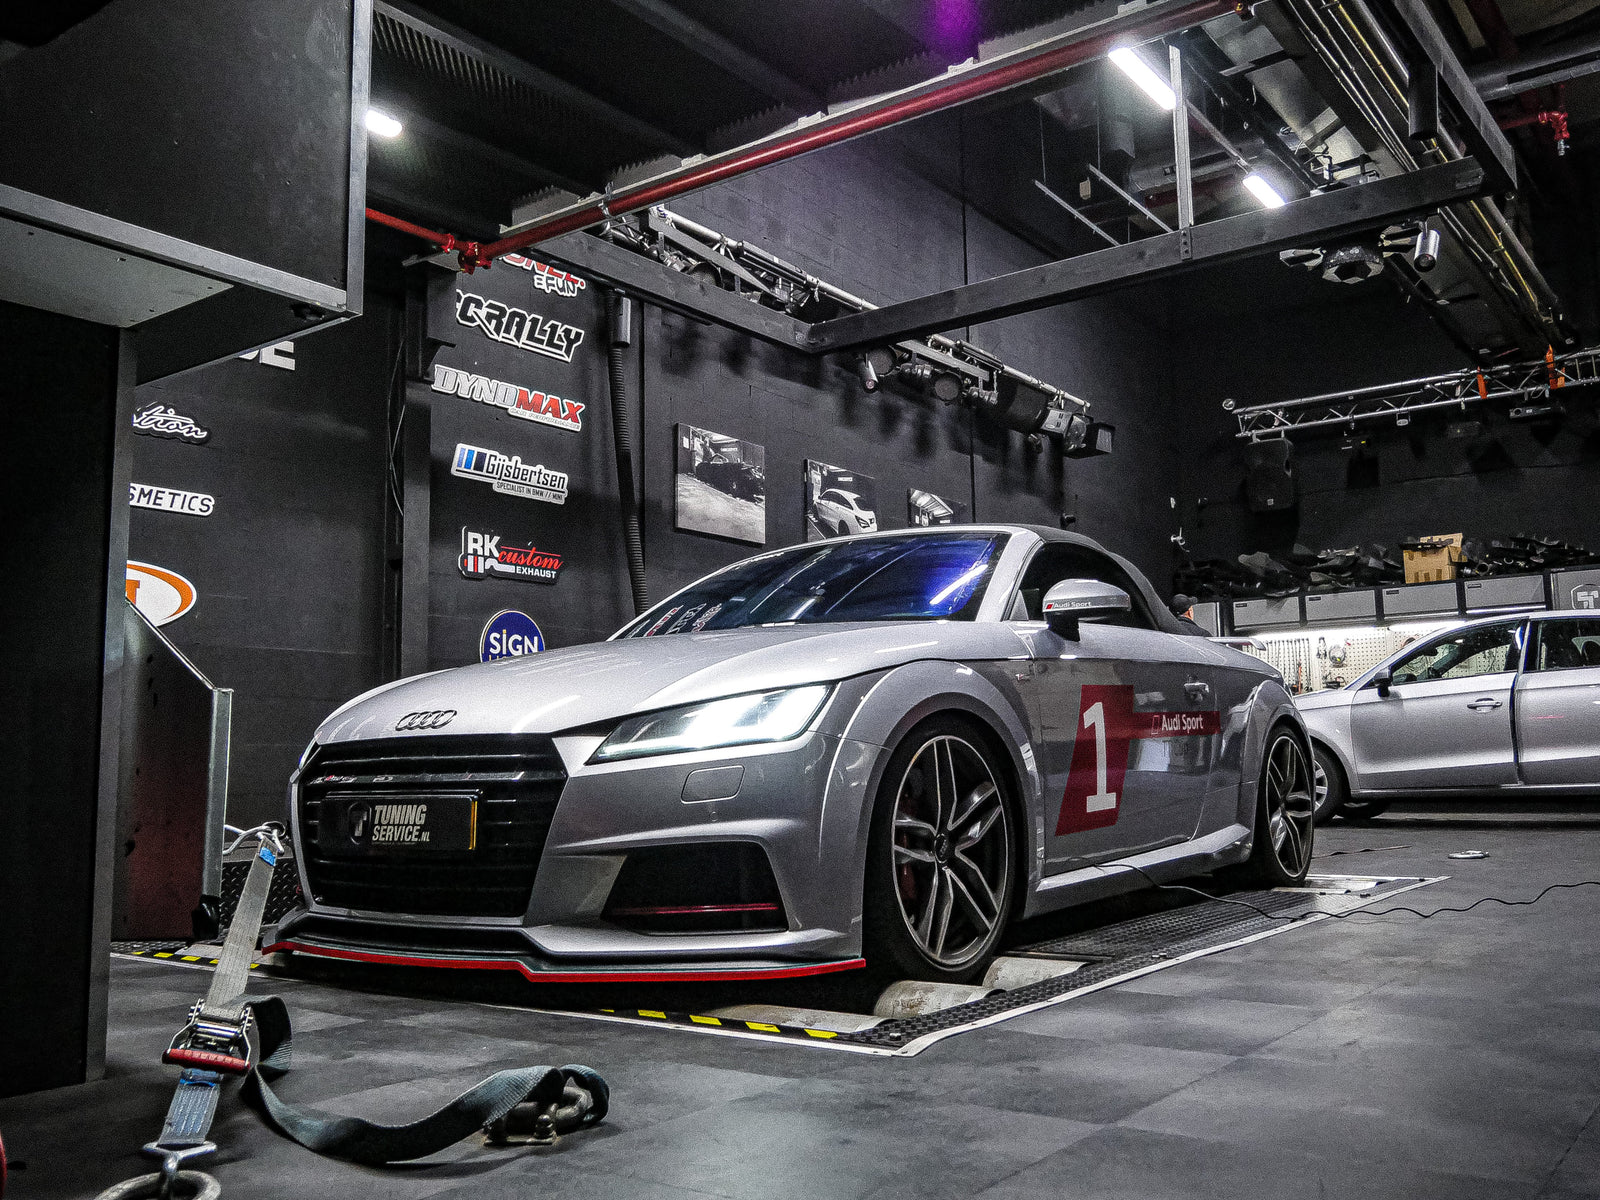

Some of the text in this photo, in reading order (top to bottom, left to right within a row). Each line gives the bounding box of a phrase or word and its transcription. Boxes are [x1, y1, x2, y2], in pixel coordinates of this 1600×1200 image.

[432, 364, 585, 425] DYNOMAX
[485, 453, 566, 490] Gijsbertsen
[496, 481, 526, 493] SPECIALIST
[467, 531, 564, 570] RK custom
[516, 566, 557, 579] EXHAUST
[1161, 713, 1204, 734] Audi Sport
[1083, 701, 1117, 813] 1
[374, 804, 428, 825] TUNING
